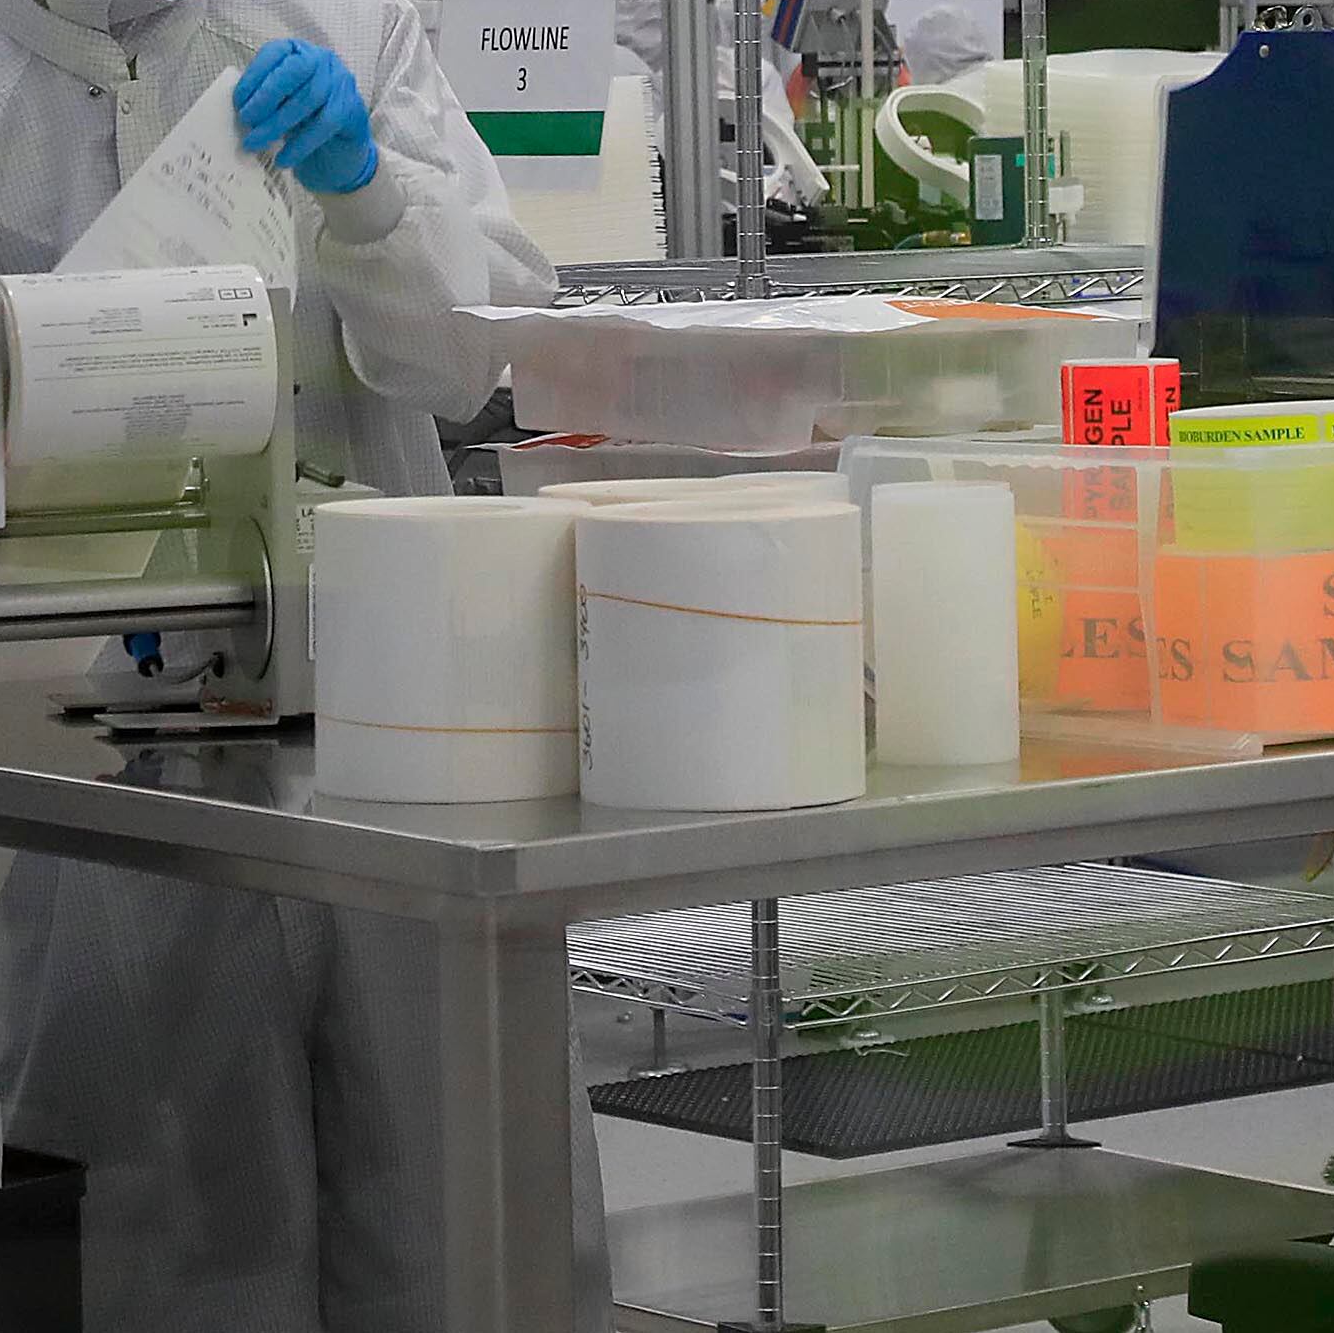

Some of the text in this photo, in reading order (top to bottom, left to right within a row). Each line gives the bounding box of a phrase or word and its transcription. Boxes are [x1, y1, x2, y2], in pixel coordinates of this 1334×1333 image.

[481, 26, 570, 51] FLOWLINE
[516, 67, 527, 92] 3
[1244, 426, 1305, 442] SAMPLE
